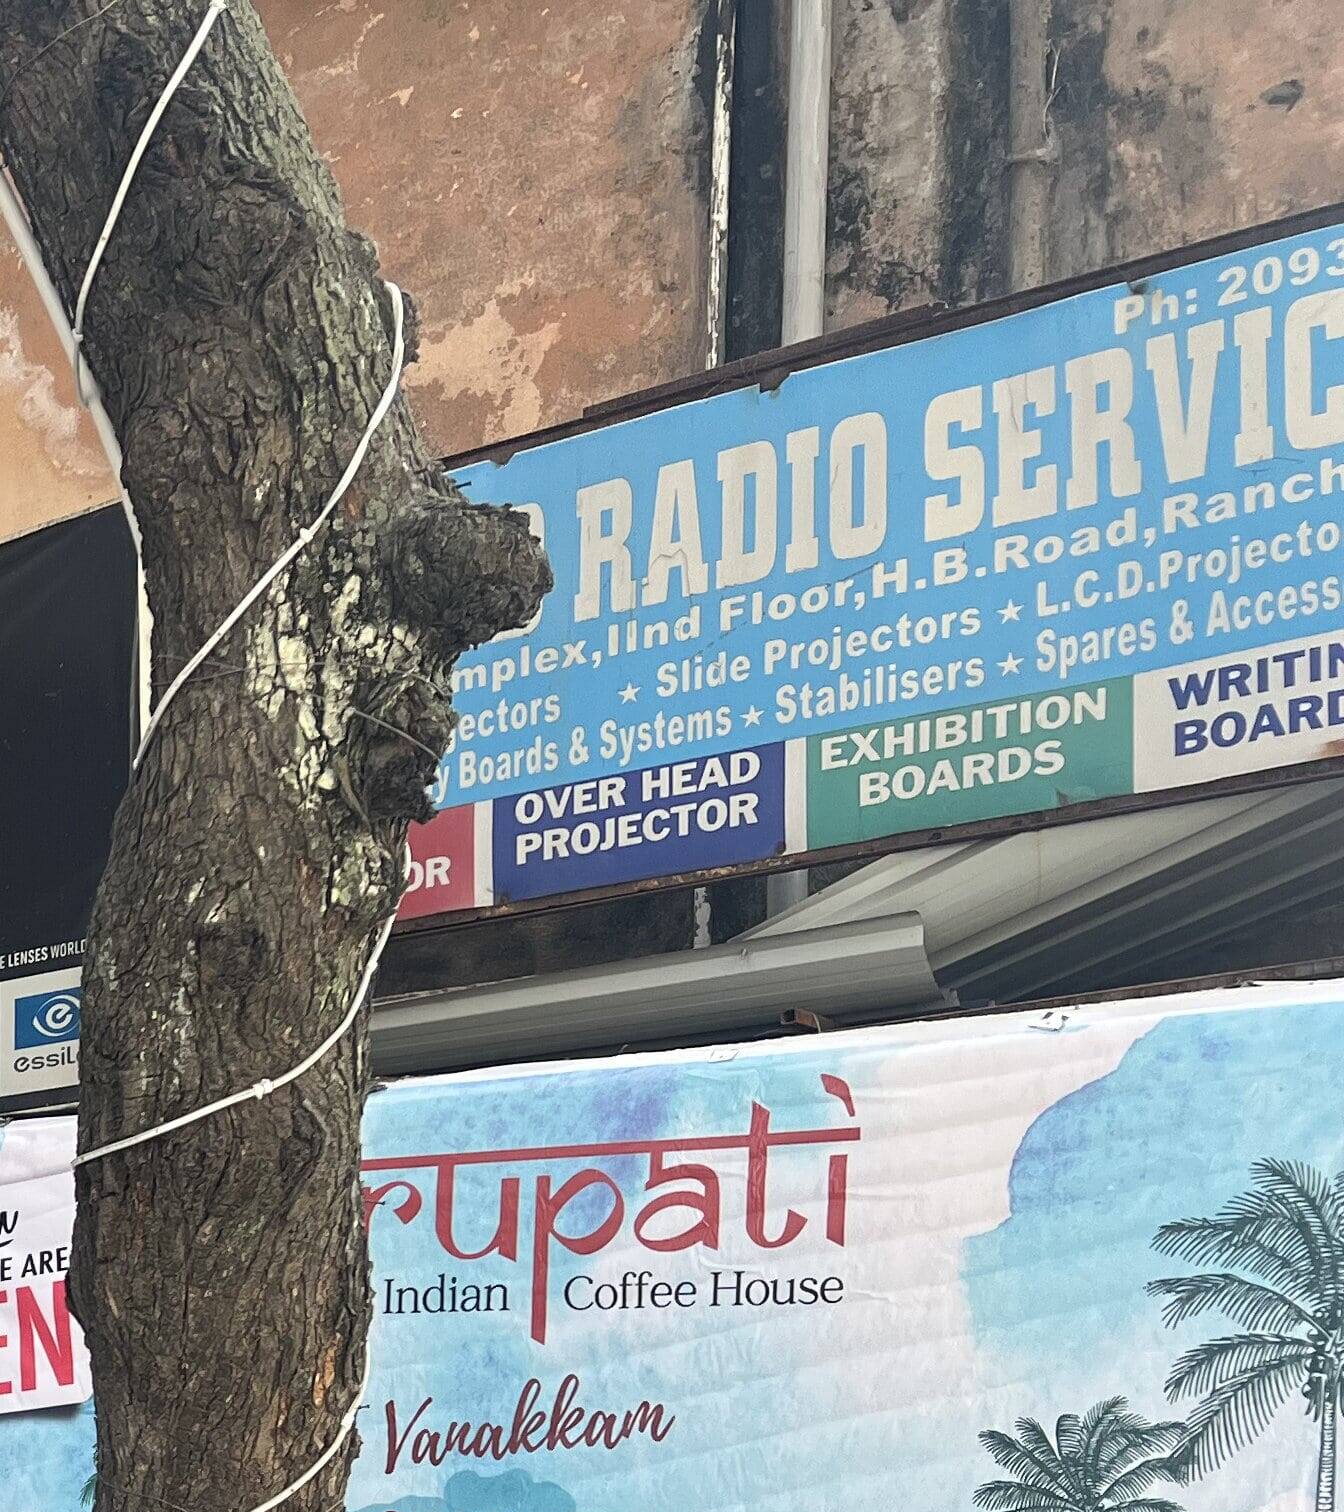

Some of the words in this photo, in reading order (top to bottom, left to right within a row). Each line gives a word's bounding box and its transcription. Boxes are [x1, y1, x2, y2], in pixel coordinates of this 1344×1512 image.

[1114, 288, 1198, 334] Ph:
[574, 411, 888, 622] RADIO
[924, 287, 1344, 542] SERVIC
[656, 651, 750, 698] Slide
[764, 607, 982, 675] Projectors
[1036, 519, 1344, 617] L.C.D.Projecto
[459, 735, 560, 790] Boards
[568, 725, 590, 766] &
[599, 703, 732, 768] Systems
[775, 657, 986, 724] Stabilisers
[1036, 616, 1157, 680] Spares
[1169, 598, 1195, 645] &
[1206, 576, 1342, 638] Access
[820, 687, 1108, 772] EXHIBITION
[515, 777, 626, 825] OVER
[641, 751, 762, 803] HEAD
[859, 739, 1066, 808] BOARDS
[515, 792, 760, 866] PROJECTOR
[7, 946, 49, 968] LENSES
[14, 1046, 80, 1073] essil
[21, 1247, 70, 1278] ARE
[382, 1271, 510, 1315] Indian
[563, 1270, 697, 1311] Coffee
[709, 1269, 845, 1308] House
[384, 1374, 676, 1475] Vanakkam
